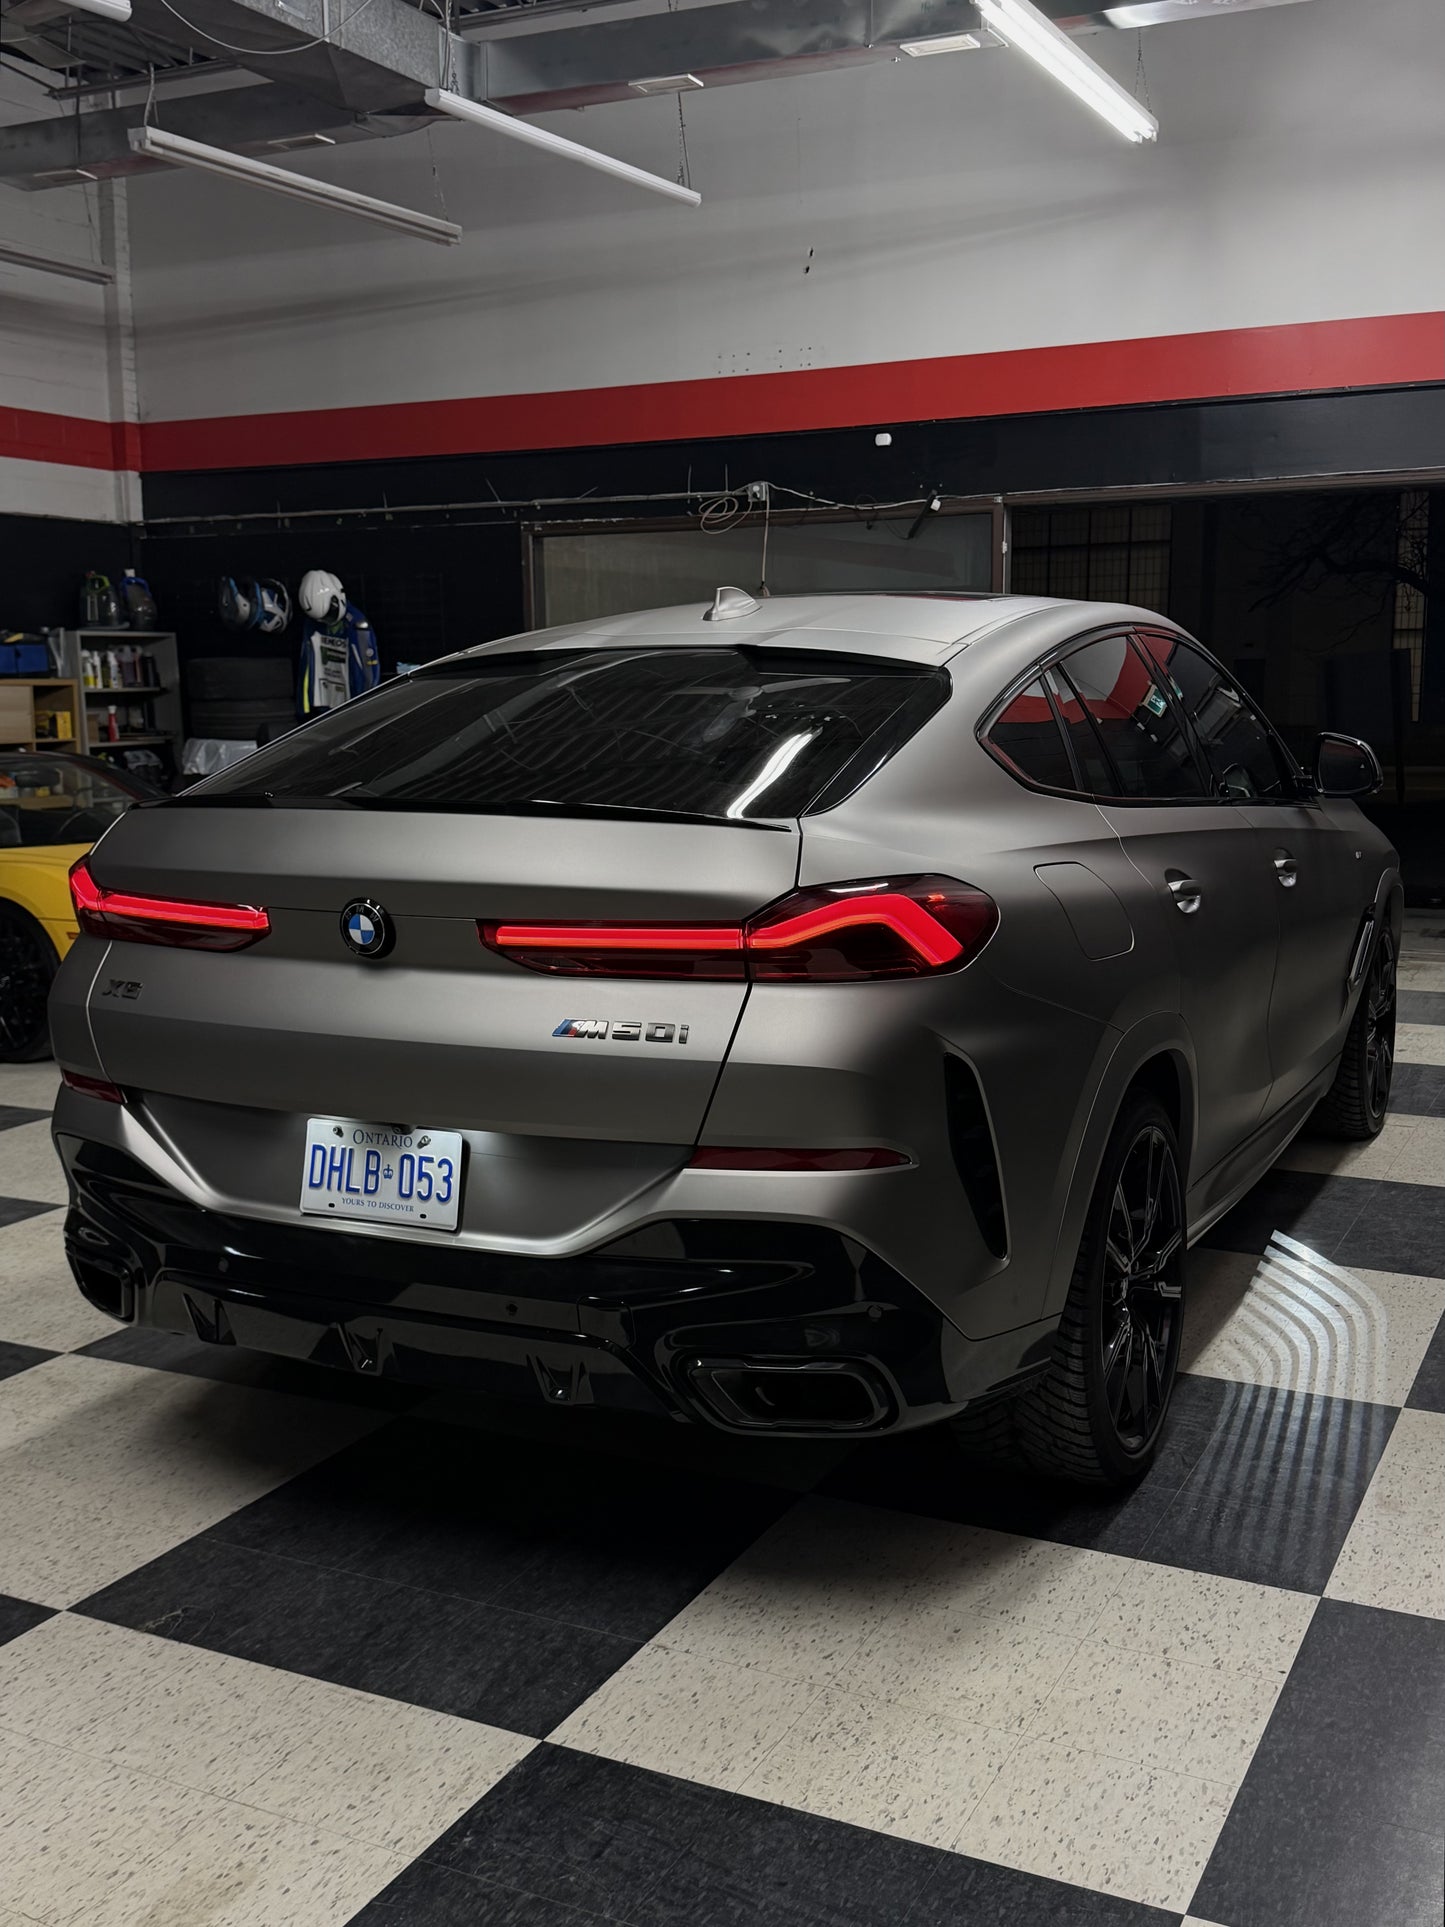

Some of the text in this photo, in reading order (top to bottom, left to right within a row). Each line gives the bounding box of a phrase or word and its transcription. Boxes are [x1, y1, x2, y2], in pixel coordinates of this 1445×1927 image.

[308, 1143, 454, 1204] DHLB 053
[341, 1197, 414, 1212] YOURS TO DISCOVER
